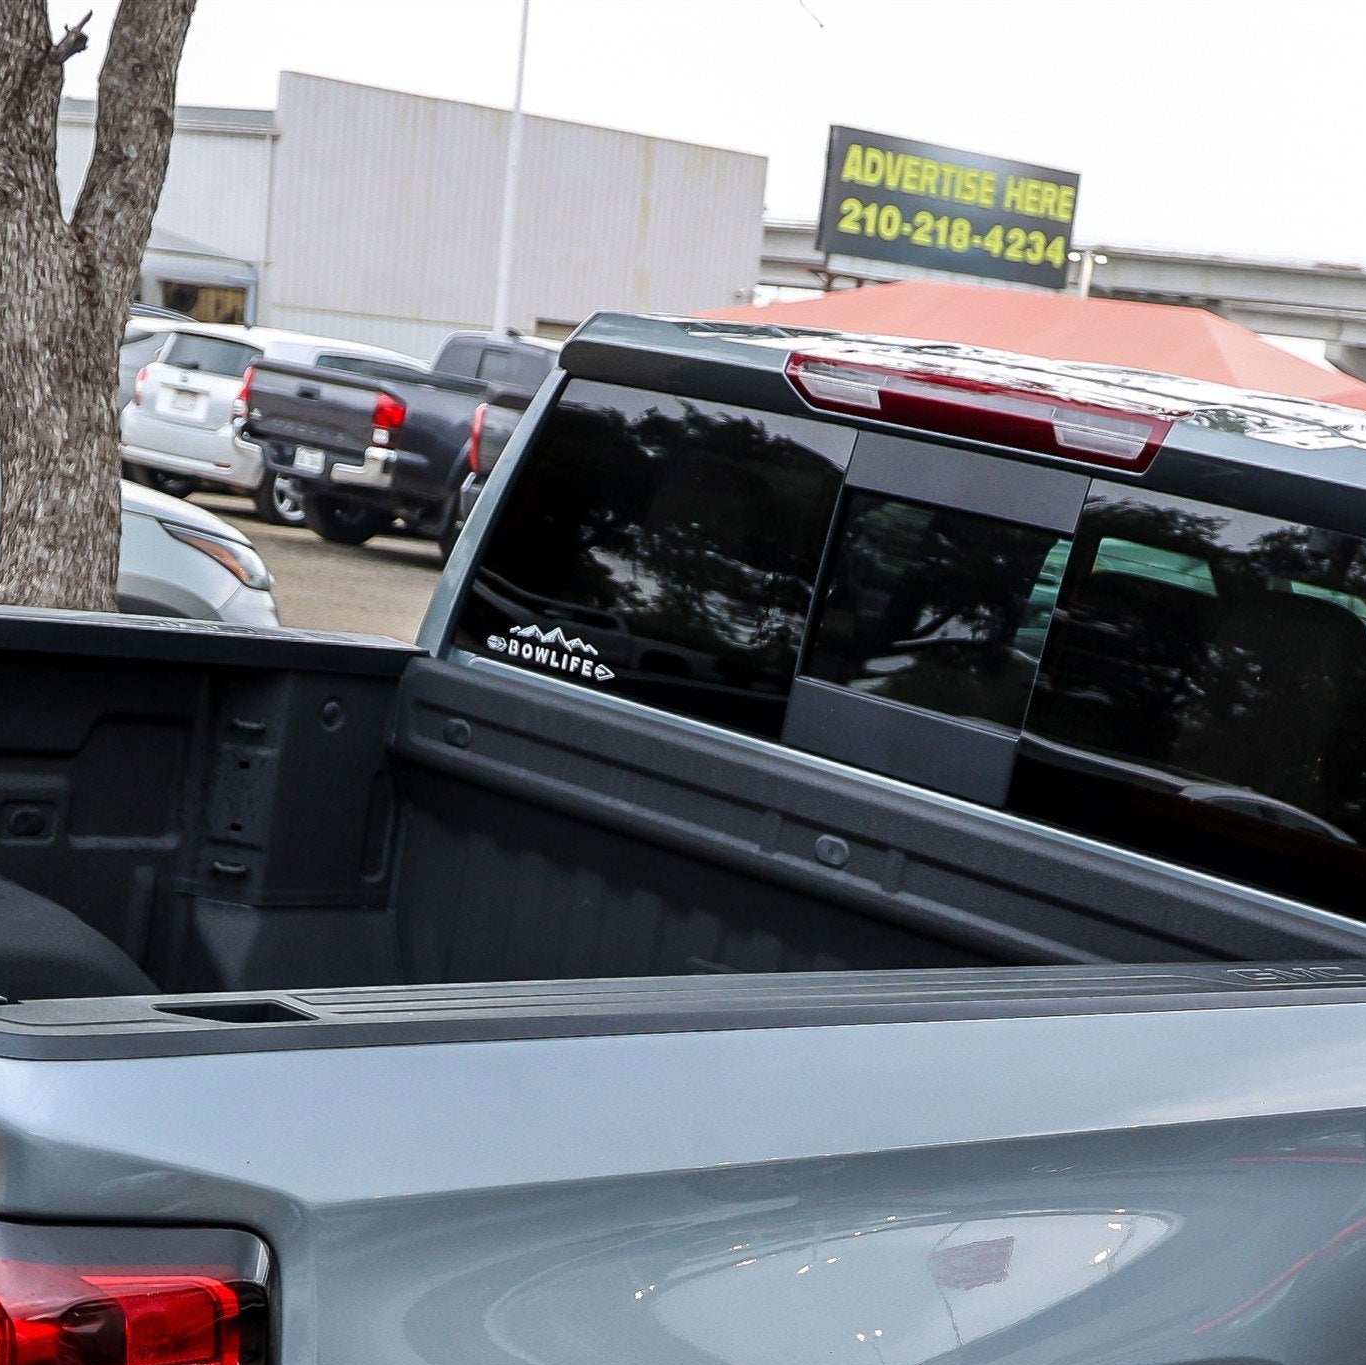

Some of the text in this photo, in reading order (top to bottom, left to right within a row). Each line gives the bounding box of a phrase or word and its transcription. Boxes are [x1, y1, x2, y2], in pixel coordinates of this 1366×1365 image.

[840, 143, 1075, 223] ADVERTISE HERE
[837, 198, 1066, 268] 210-218-4234
[508, 639, 595, 678] BOWLIFE
